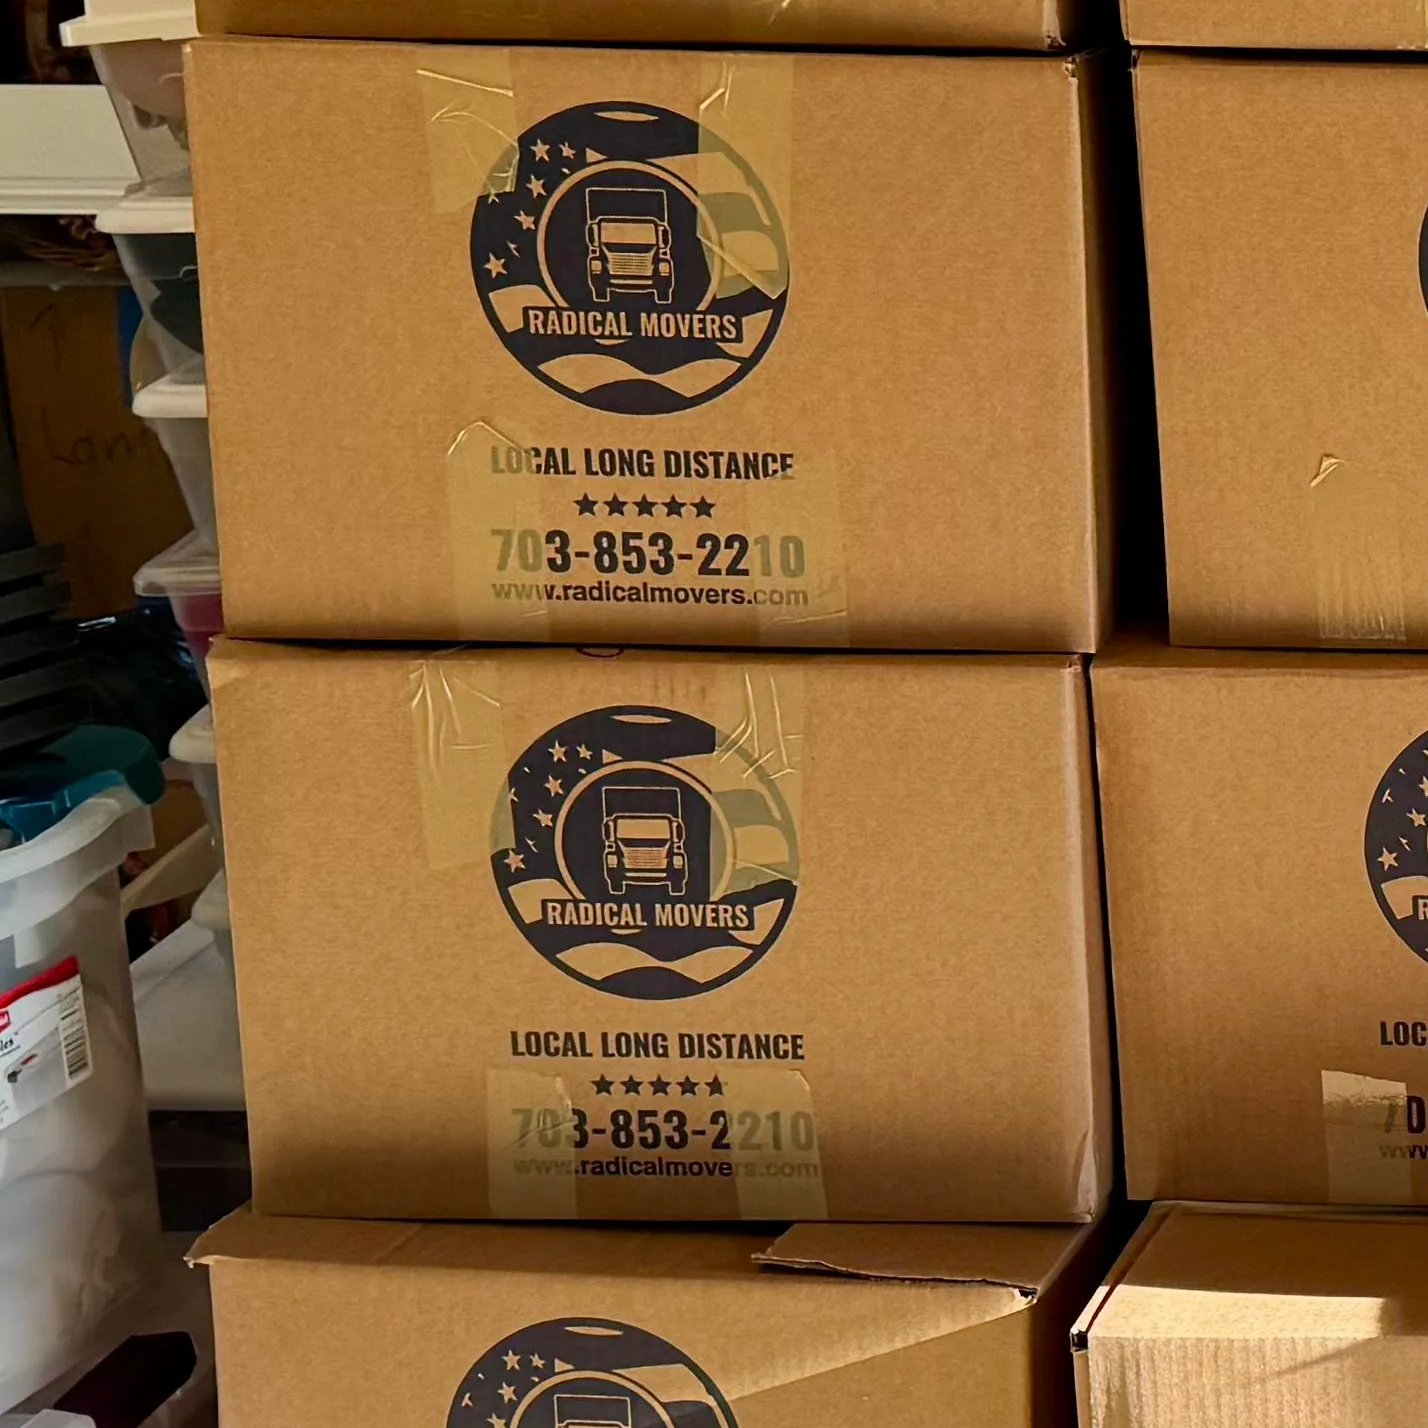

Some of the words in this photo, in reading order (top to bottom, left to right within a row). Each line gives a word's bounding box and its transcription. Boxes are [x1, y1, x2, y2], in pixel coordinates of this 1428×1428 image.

[529, 309, 632, 336] RADICAL
[640, 313, 737, 339] MOVERS
[491, 446, 576, 475] LOCAL
[584, 448, 655, 477] LONG
[664, 450, 795, 480] DISTANCE
[490, 528, 806, 578] 703-853-2210
[547, 902, 647, 926] RADICAL
[655, 904, 750, 928] MOVERS
[511, 1031, 592, 1058] LOCAL
[601, 1031, 668, 1058] LONG
[678, 1033, 805, 1061] DISTANCE
